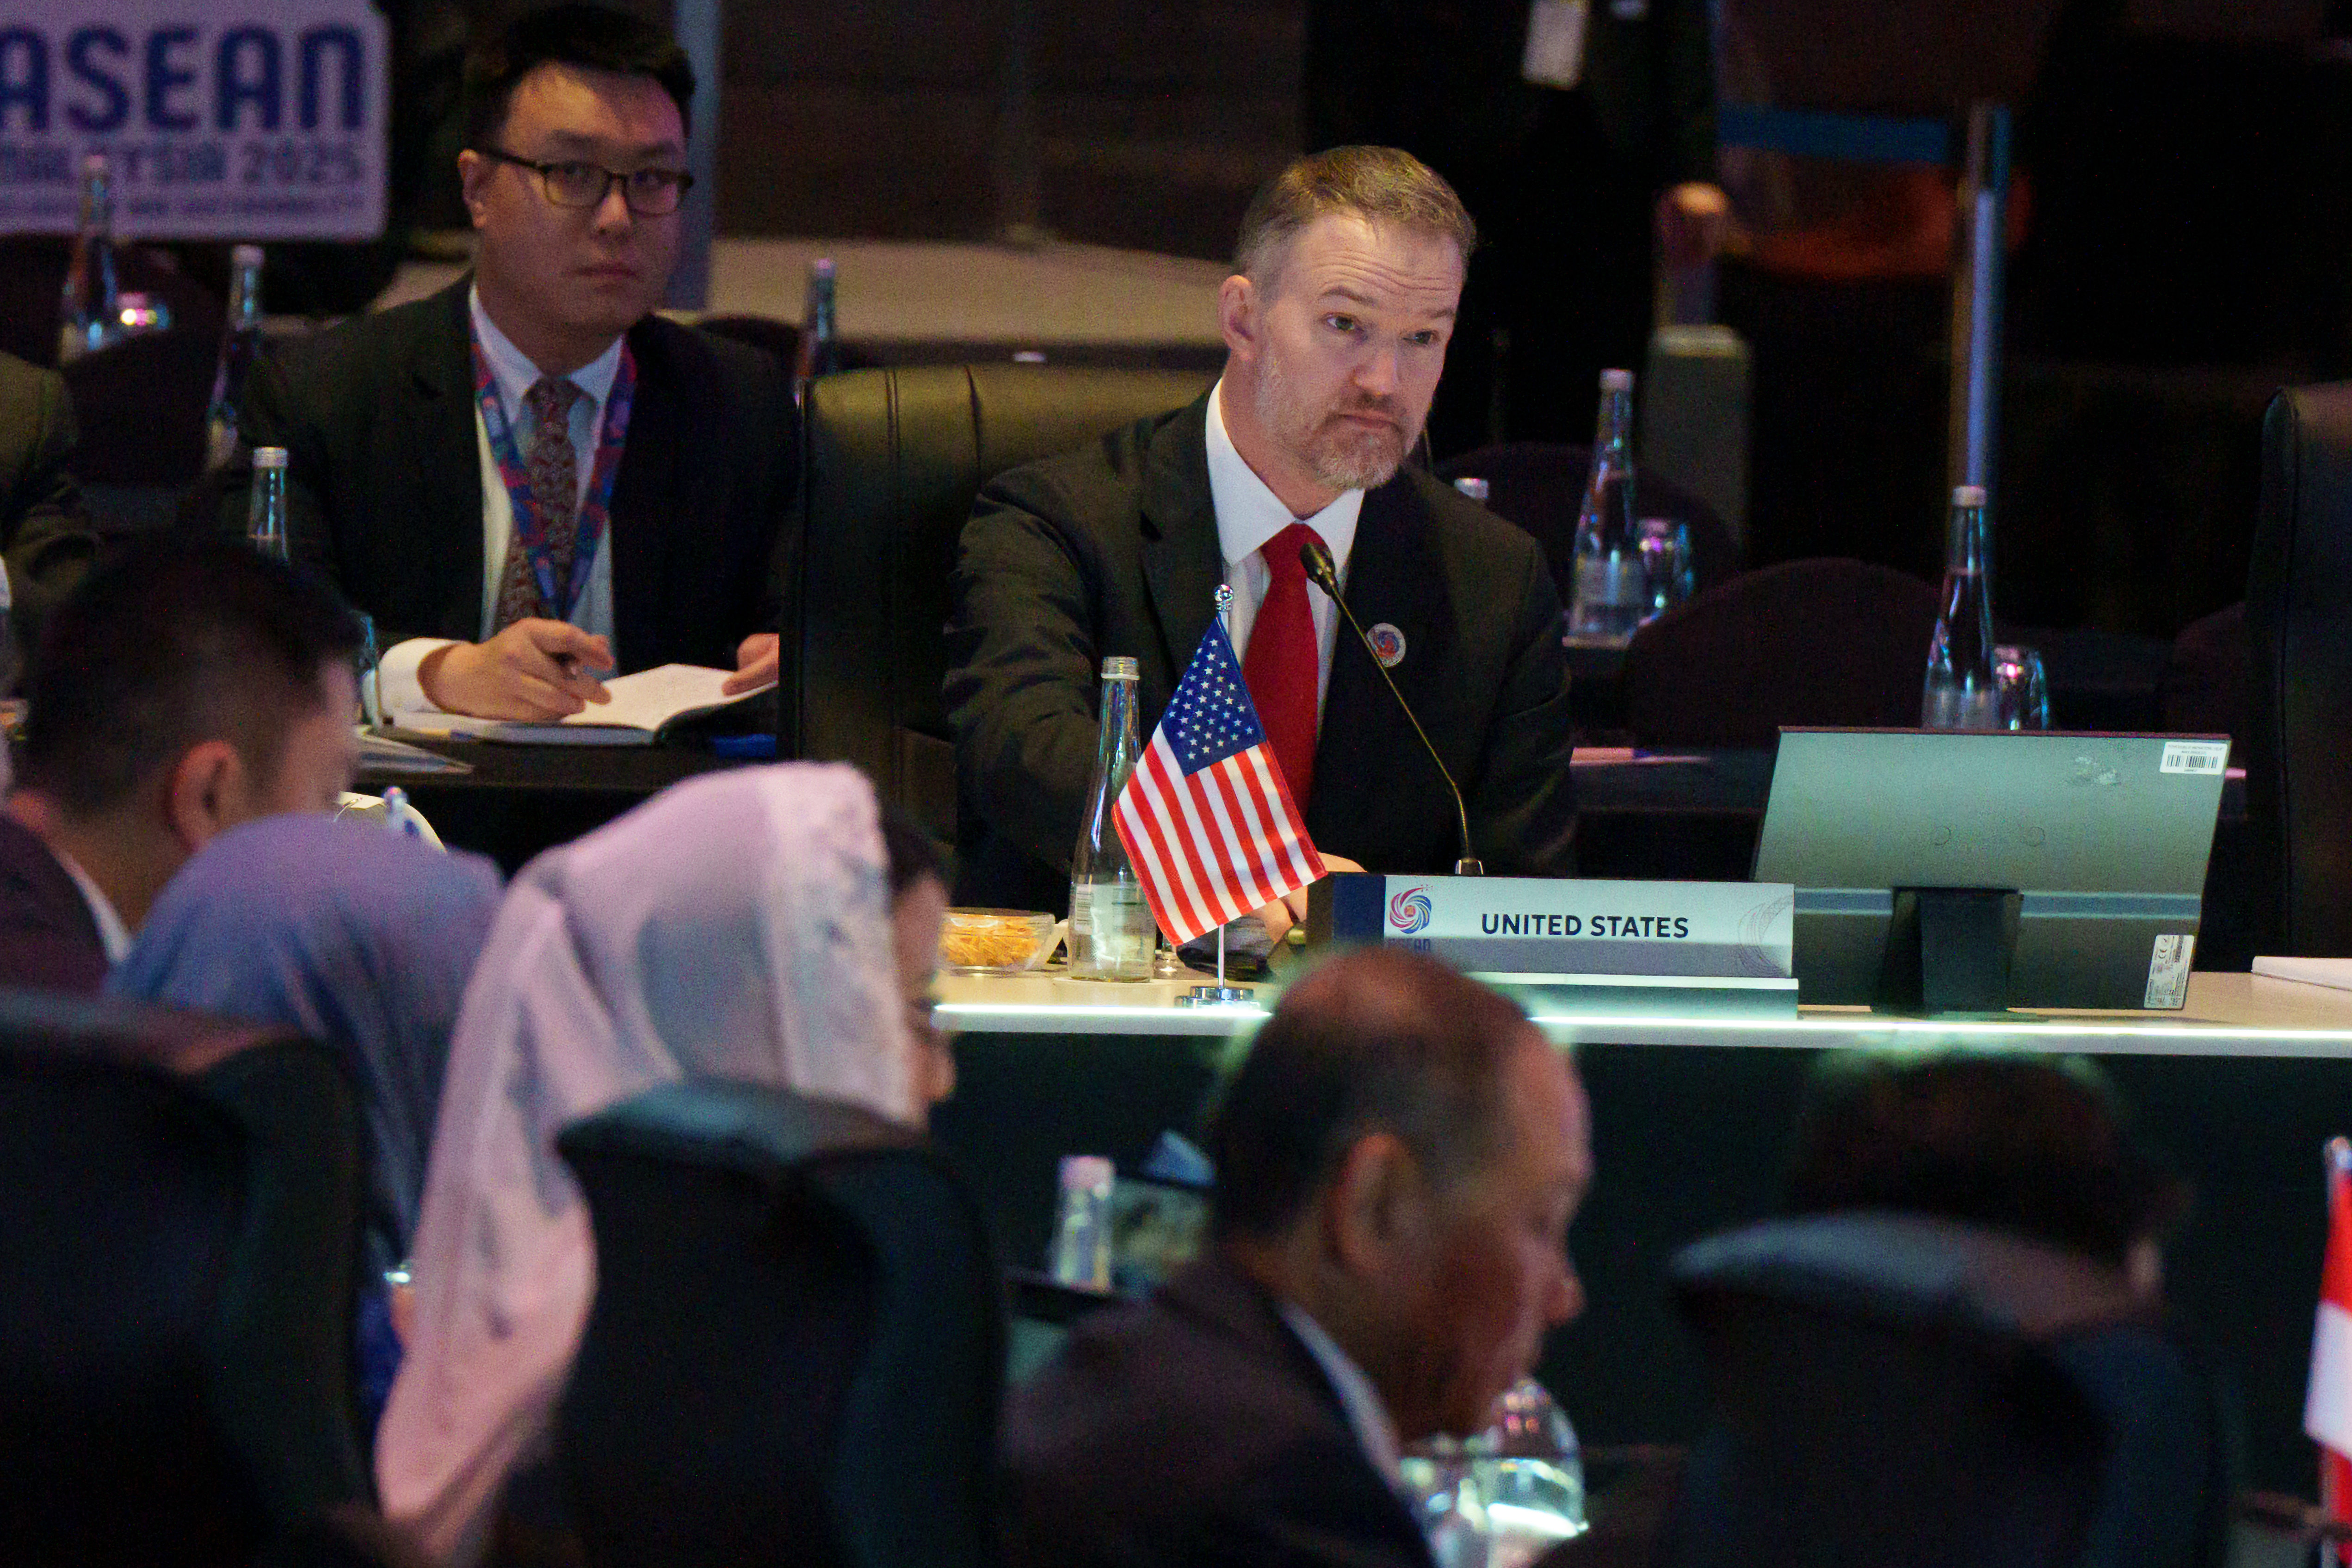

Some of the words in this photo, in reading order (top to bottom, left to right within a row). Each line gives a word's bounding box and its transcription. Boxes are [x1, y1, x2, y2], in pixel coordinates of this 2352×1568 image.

[0, 24, 364, 132] ASEAN
[244, 142, 364, 183] 2025
[1482, 913, 1582, 936] UNITED
[1590, 915, 1689, 938] STATES
